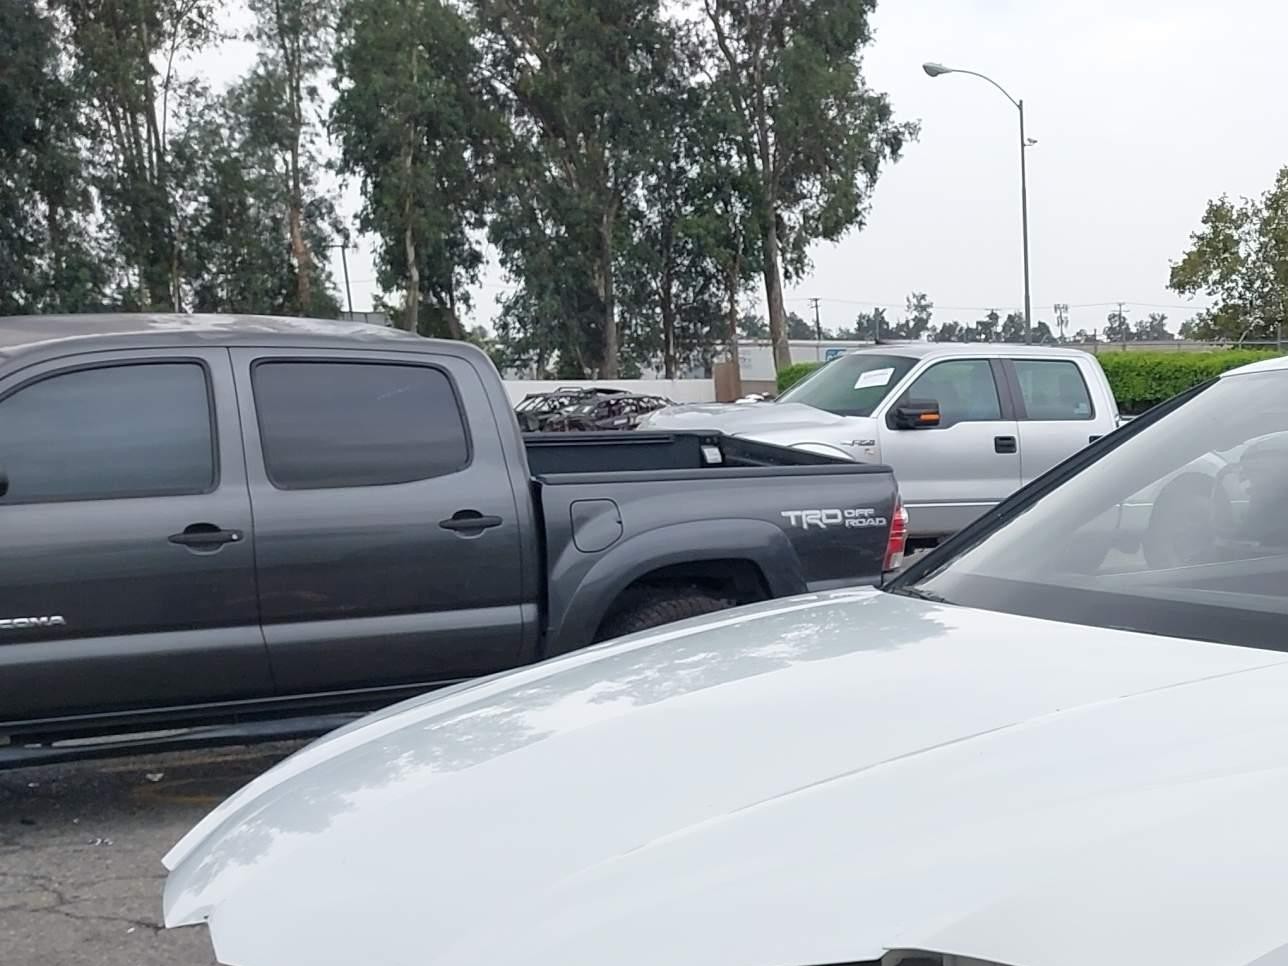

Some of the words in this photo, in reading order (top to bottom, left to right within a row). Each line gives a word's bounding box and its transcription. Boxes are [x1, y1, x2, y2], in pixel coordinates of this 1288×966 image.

[780, 508, 842, 530] TRD
[844, 508, 875, 518] OFF
[845, 517, 887, 528] ROAD
